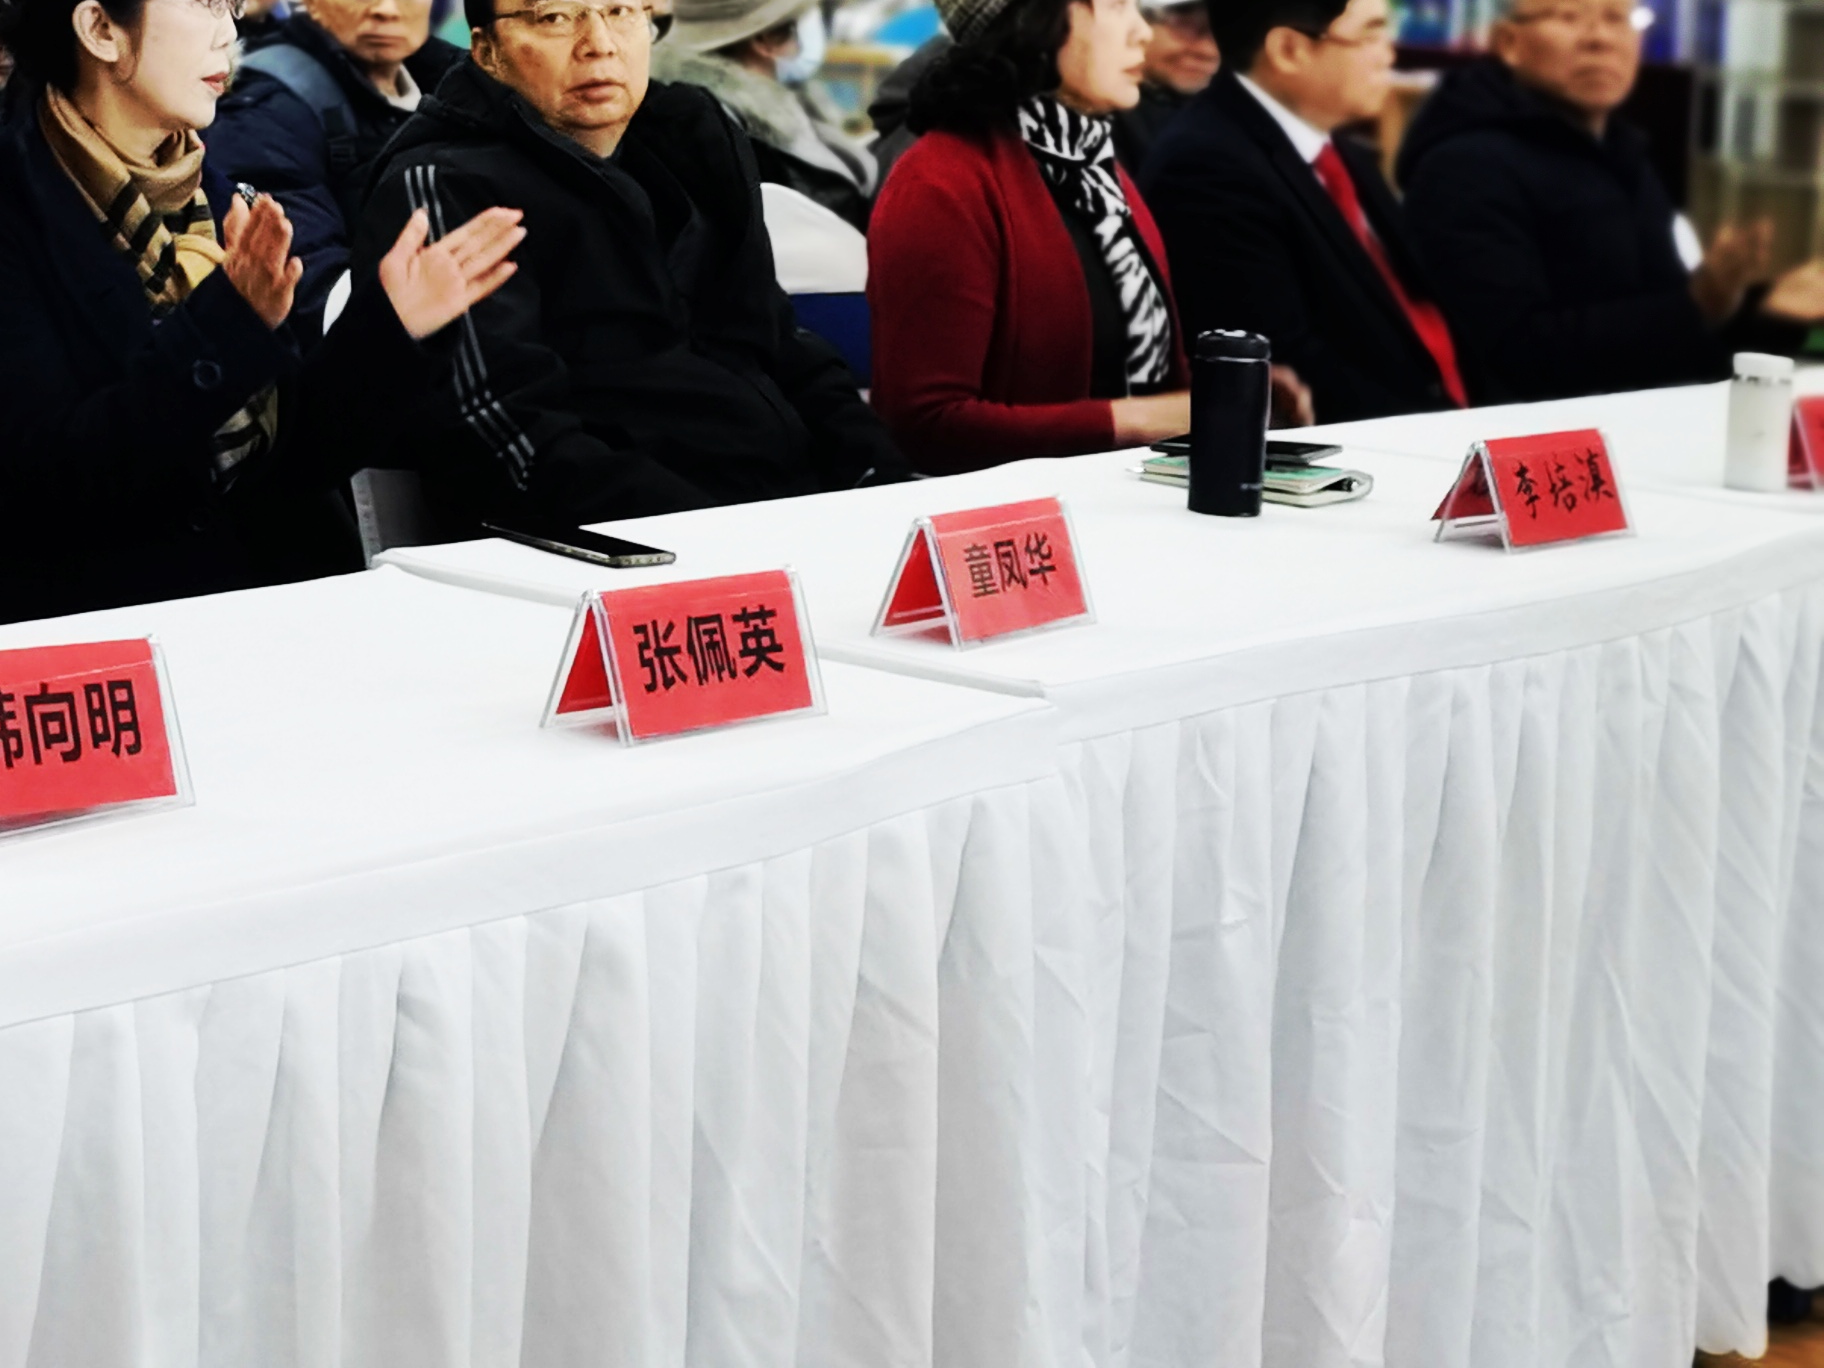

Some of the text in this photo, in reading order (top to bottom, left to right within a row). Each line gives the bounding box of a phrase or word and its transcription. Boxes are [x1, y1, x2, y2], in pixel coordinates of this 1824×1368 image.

[963, 531, 1057, 599] 童凤华
[632, 603, 786, 694] 张佩英
